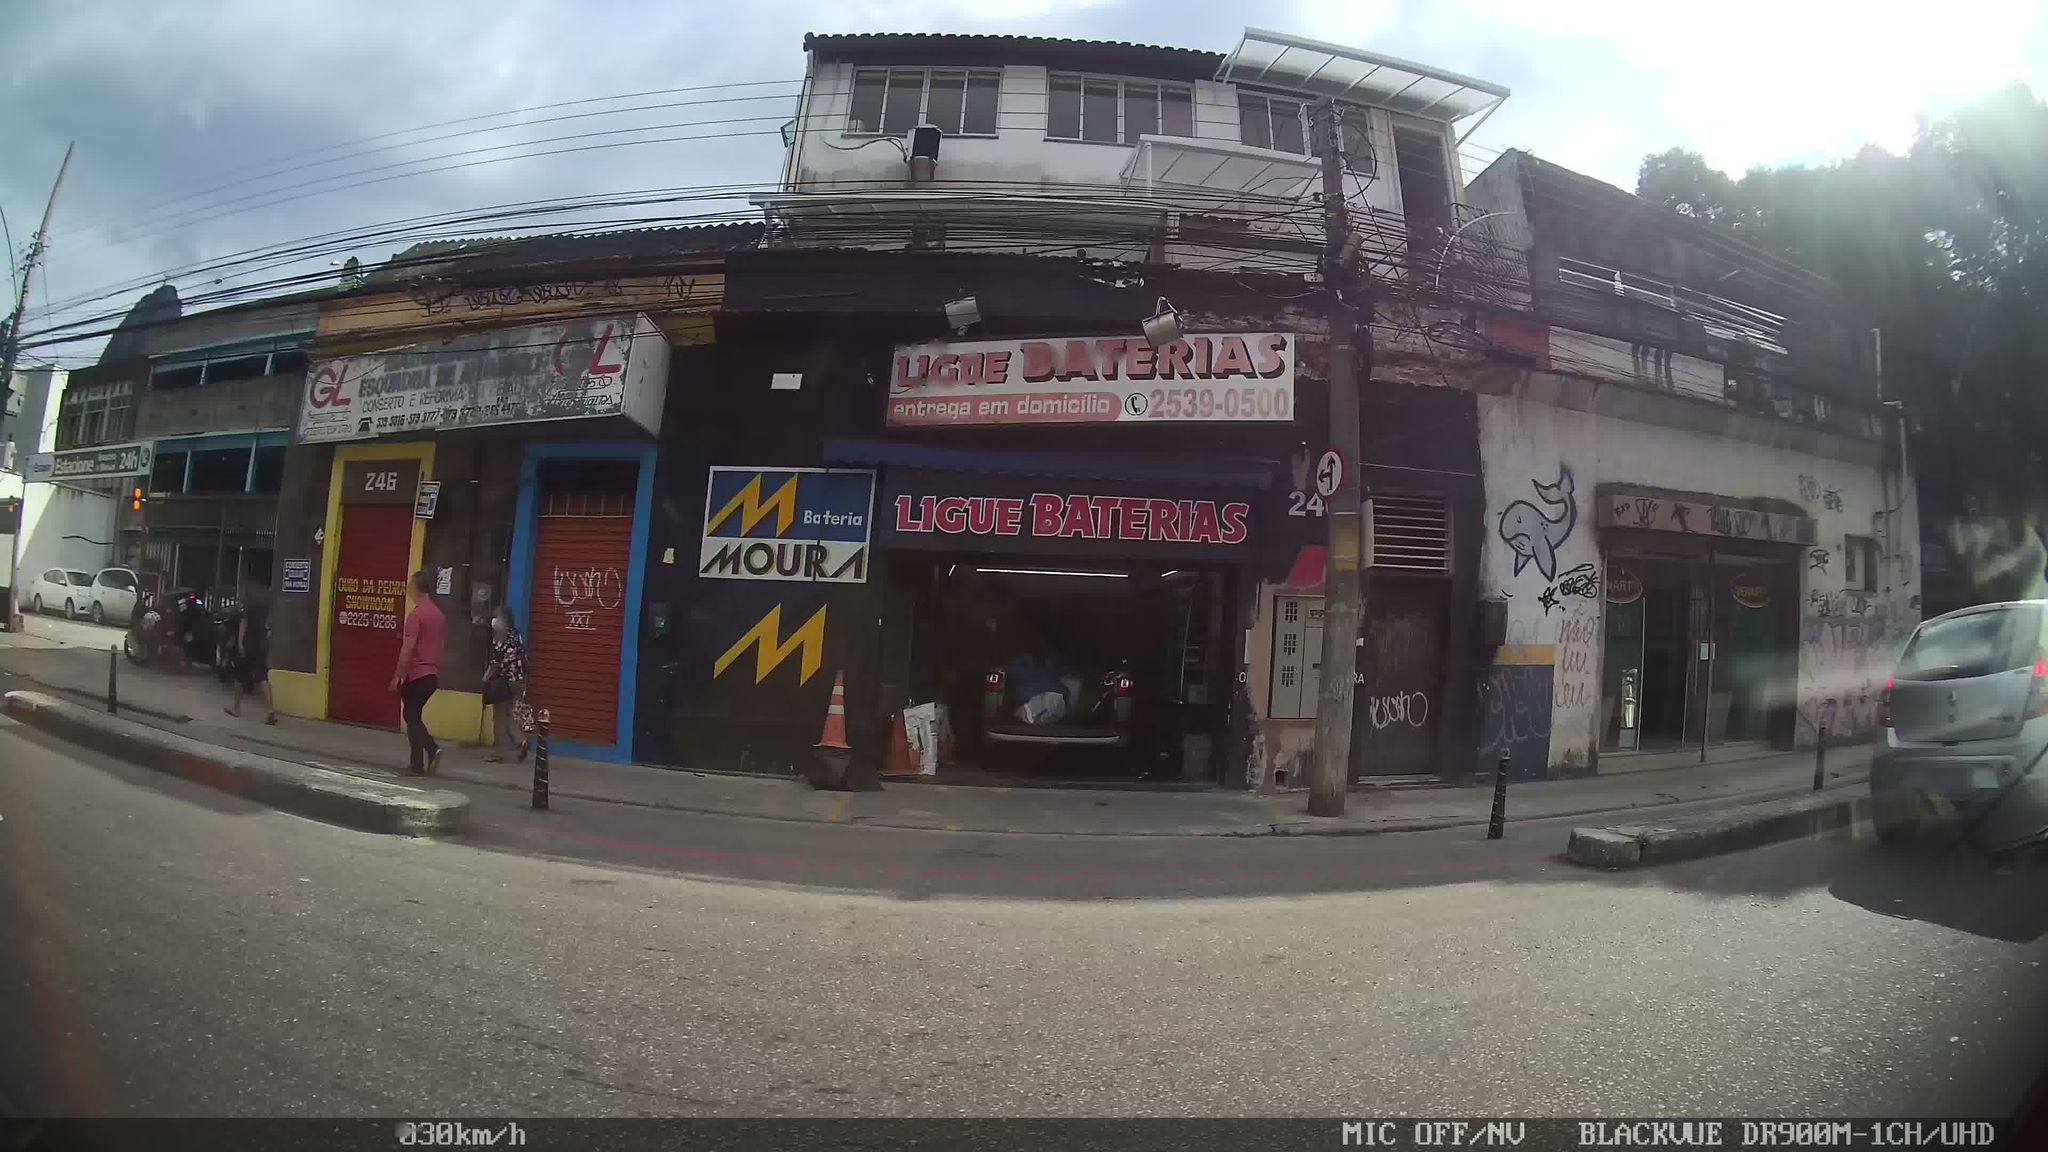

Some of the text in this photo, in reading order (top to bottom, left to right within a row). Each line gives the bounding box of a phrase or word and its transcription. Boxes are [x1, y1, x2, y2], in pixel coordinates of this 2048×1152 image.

[898, 333, 1288, 388] LIGUE BATERIAS
[893, 393, 1110, 420] entrega em domicílio
[1150, 387, 1290, 419] 2539-0500
[119, 450, 138, 471] 24h
[364, 471, 399, 491] 246
[1288, 490, 1329, 517] 24
[803, 510, 863, 527] Bateria
[894, 493, 1250, 545] LIGUE BATERIAS
[700, 542, 866, 580] MOURA
[362, 579, 375, 595] DA
